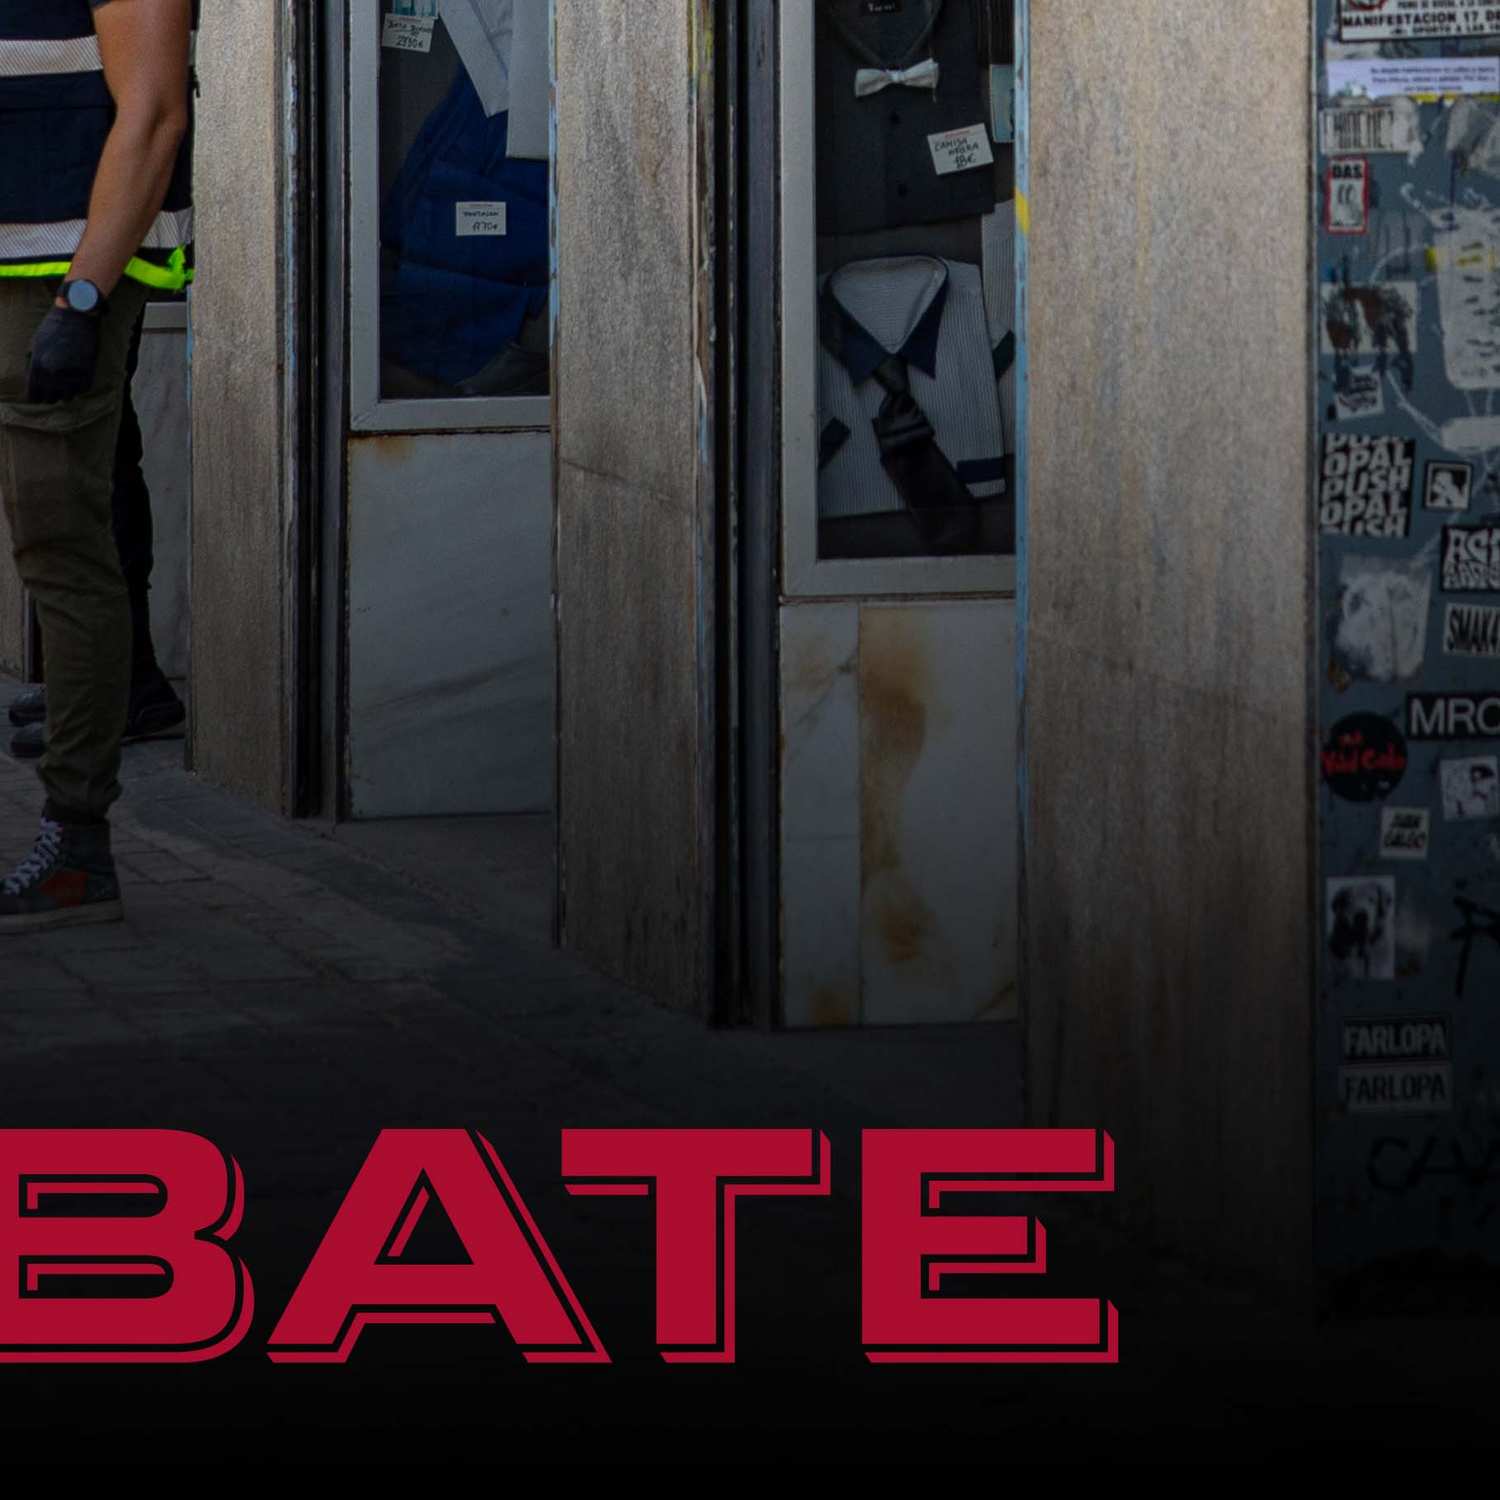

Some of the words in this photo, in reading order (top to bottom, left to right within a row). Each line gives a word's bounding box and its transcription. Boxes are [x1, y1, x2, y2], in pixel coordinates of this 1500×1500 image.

[1322, 441, 1413, 477] OPAL
[1320, 464, 1411, 502] PUSH
[1318, 490, 1410, 527] OPAL
[1344, 1022, 1448, 1055] FARLOPA
[1343, 1072, 1448, 1105] FARLOPA
